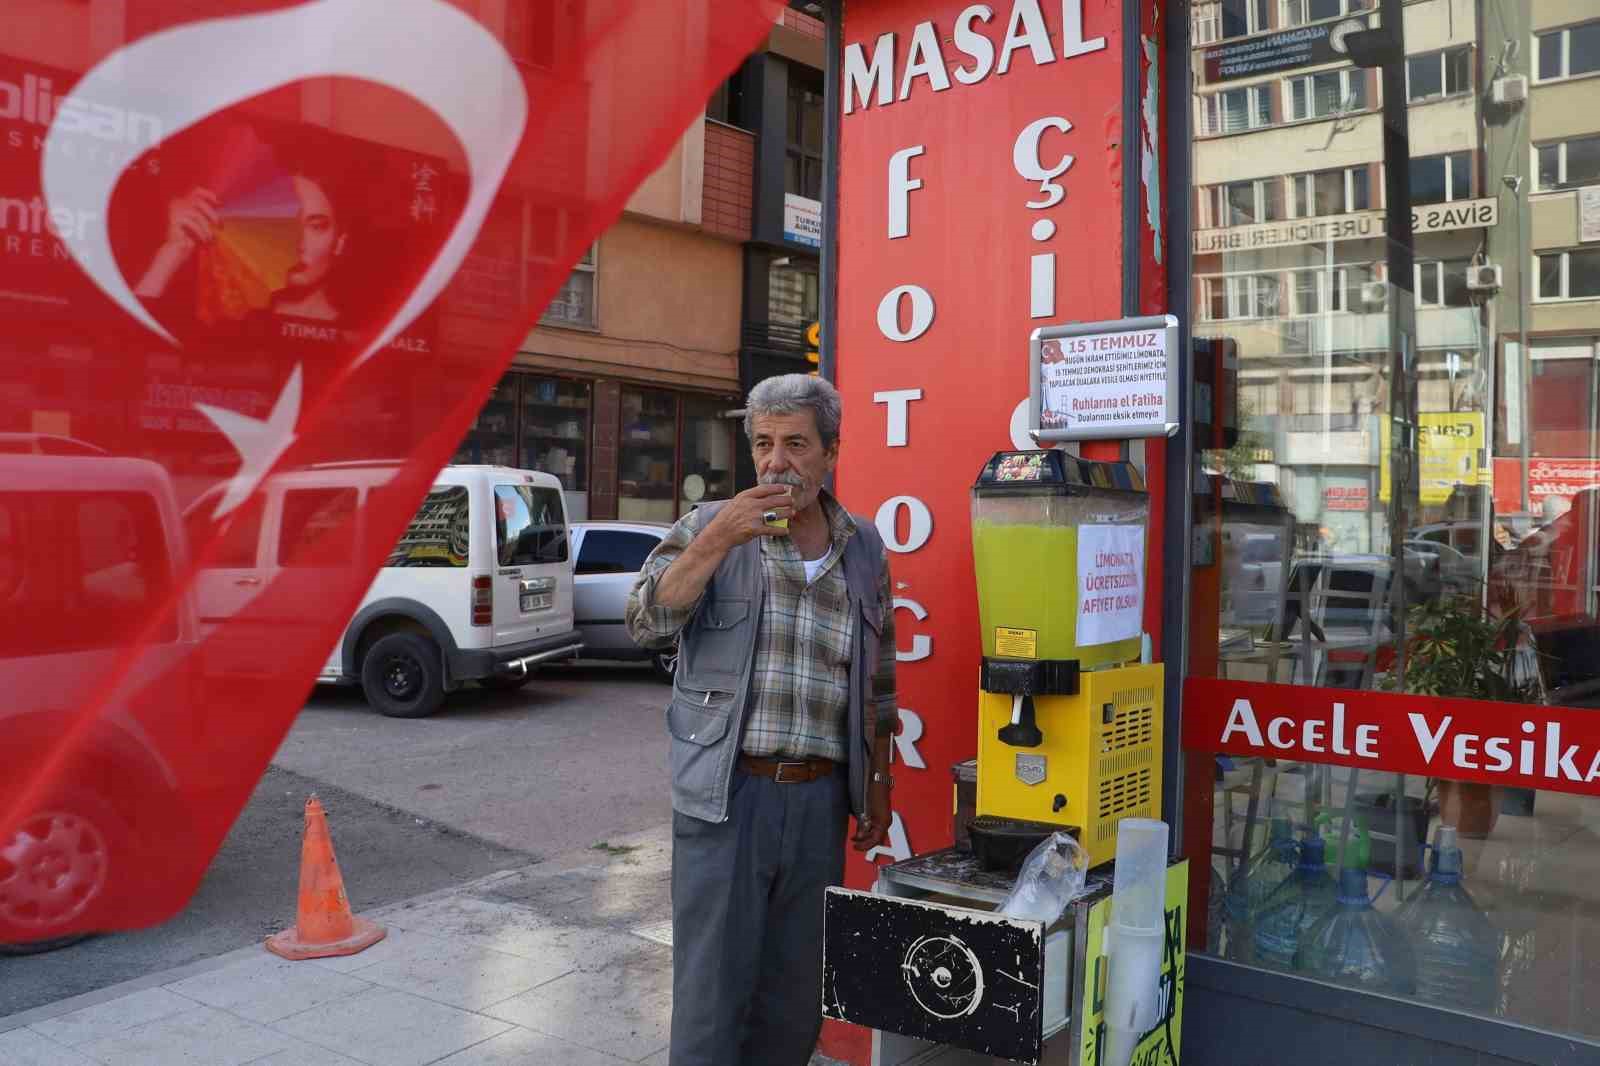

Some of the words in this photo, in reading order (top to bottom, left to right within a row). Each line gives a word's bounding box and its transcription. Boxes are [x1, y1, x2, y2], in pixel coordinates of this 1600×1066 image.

[843, 0, 1106, 115] MASAL
[1069, 340, 1086, 353] 15
[1090, 333, 1157, 351] TEMMUZ
[1072, 397, 1118, 411] Ruhlarına
[1120, 395, 1130, 408] el
[1131, 392, 1163, 406] Fatiha
[1113, 411, 1131, 420] eksik
[1132, 410, 1159, 421] etmeyin
